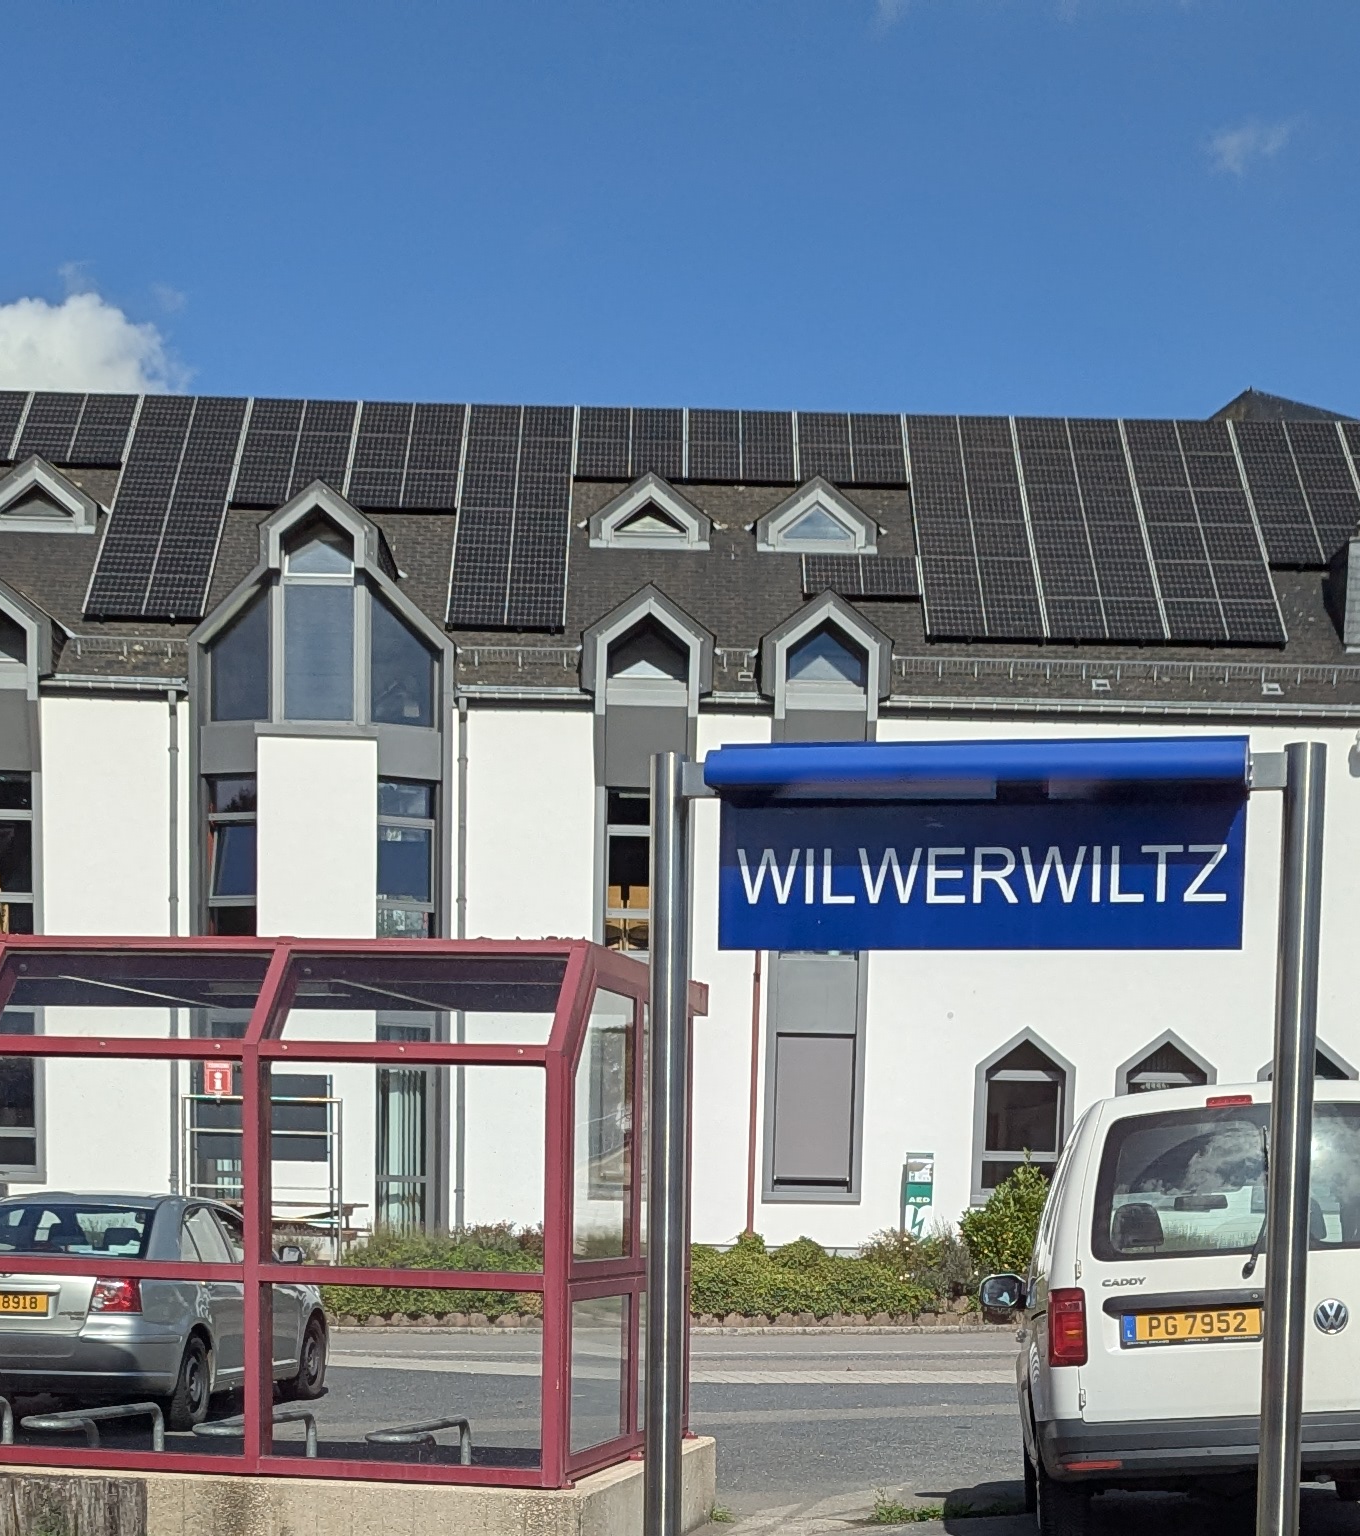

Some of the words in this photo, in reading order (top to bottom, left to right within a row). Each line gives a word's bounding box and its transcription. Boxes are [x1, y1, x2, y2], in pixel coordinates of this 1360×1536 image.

[736, 845, 1228, 905] WILWERWILTZ
[1102, 1277, 1147, 1287] CADDY
[2, 1294, 38, 1310] 8918
[1147, 1315, 1178, 1337] PG
[1184, 1312, 1248, 1334] 7952
